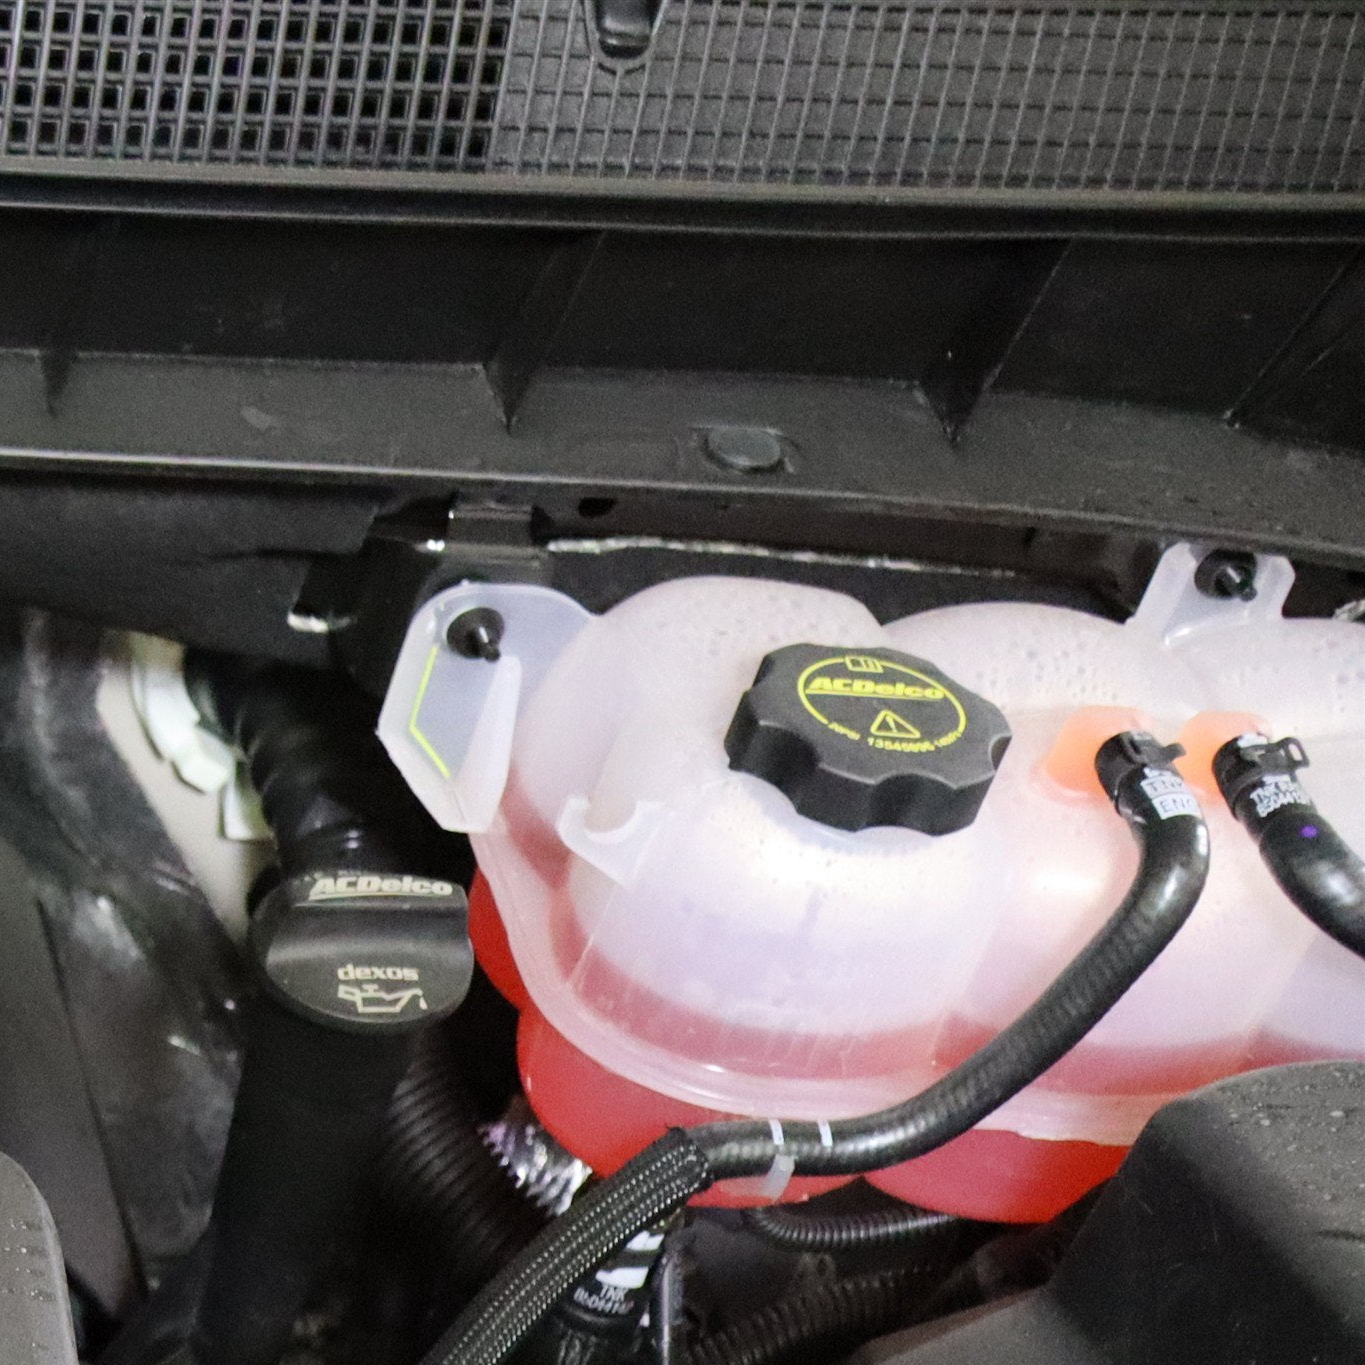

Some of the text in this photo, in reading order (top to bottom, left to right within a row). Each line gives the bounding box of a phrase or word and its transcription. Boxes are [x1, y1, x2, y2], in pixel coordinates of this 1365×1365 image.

[806, 677, 945, 699] ACDelco
[309, 875, 454, 900] ACDelco
[337, 963, 419, 982] dexos
